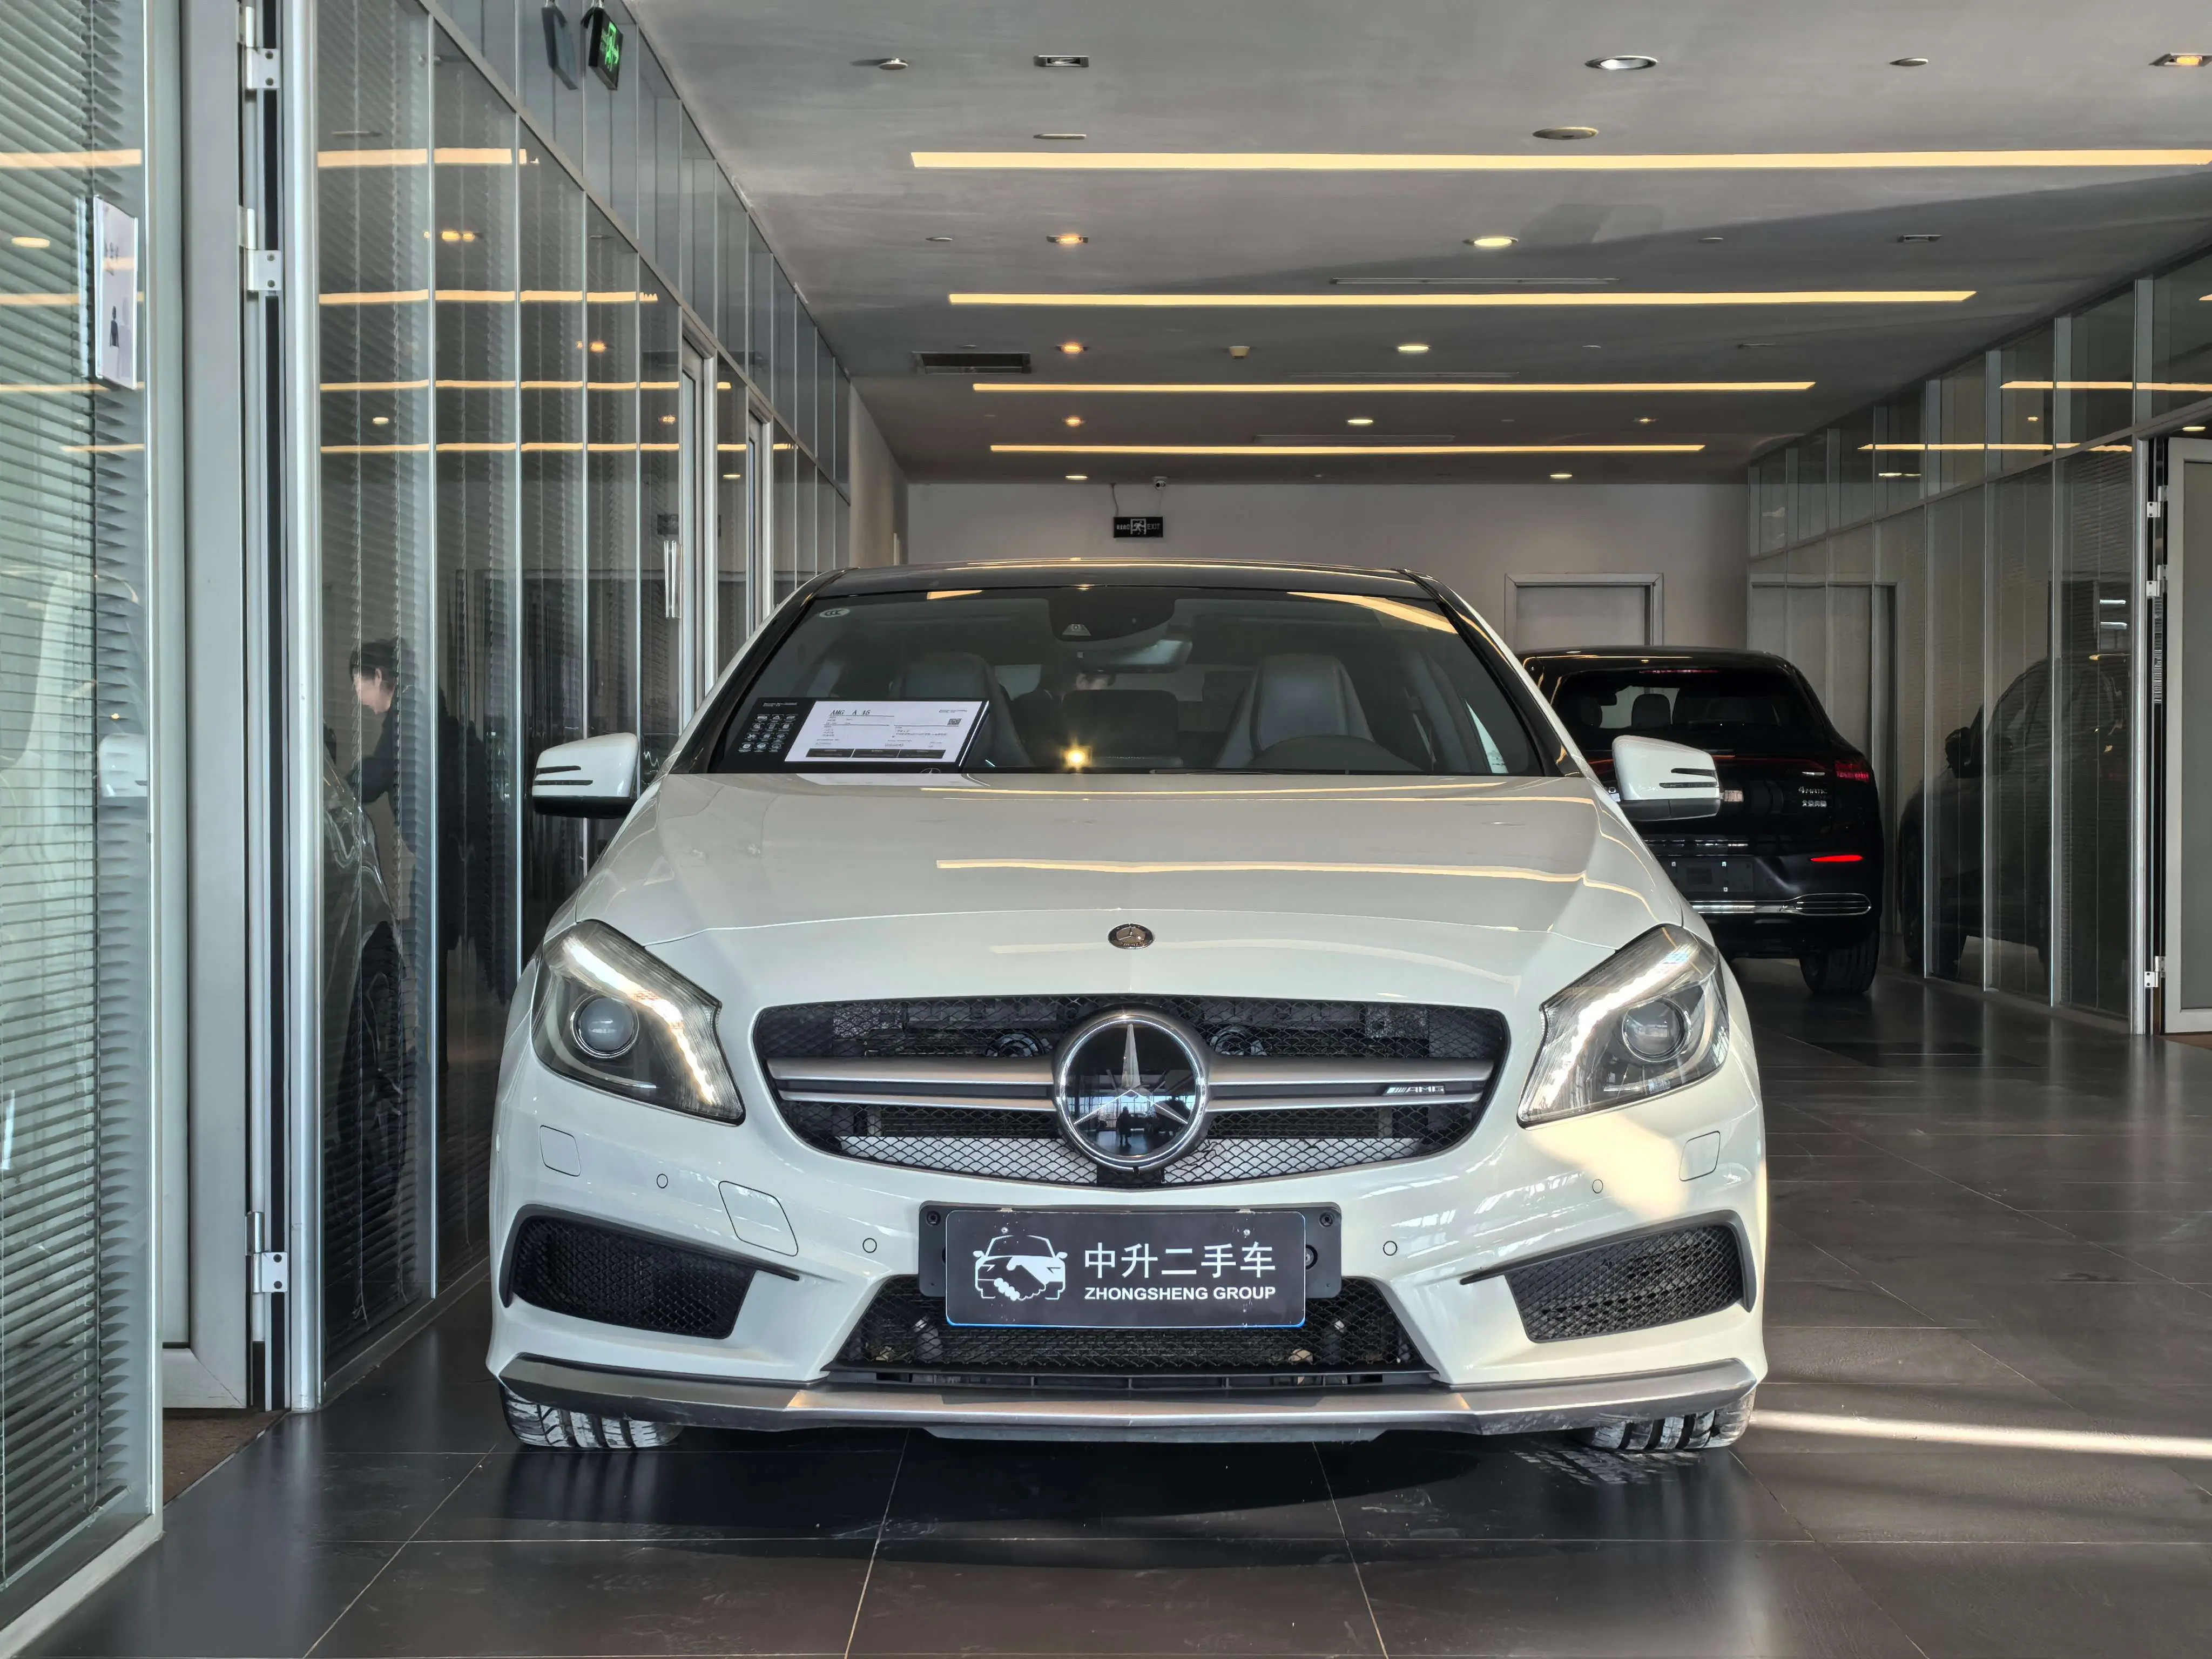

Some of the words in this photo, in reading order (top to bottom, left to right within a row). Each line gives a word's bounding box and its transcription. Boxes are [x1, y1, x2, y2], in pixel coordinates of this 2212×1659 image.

[1405, 1085, 1445, 1094] AMG
[1084, 1241, 1276, 1279] 中升二手车
[1084, 1286, 1208, 1300] ZHONGSHENG
[1213, 1285, 1276, 1300] GROUP
